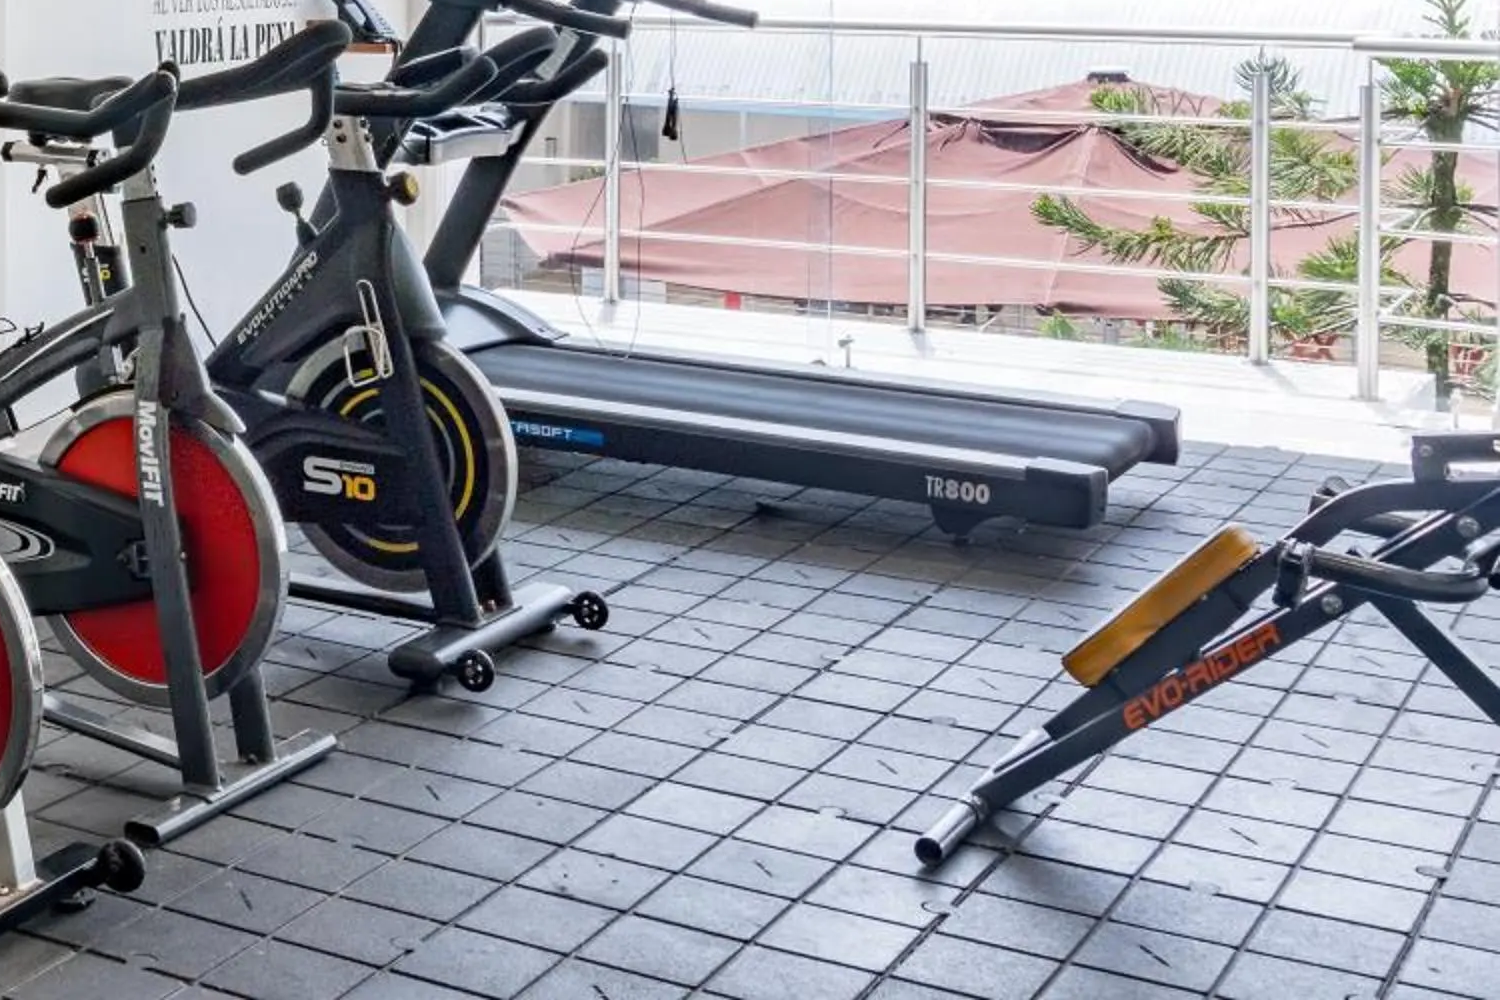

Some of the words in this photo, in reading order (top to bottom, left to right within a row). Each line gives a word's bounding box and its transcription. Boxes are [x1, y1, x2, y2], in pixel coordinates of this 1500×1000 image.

[155, 16, 225, 65] VALDRÁ
[230, 24, 250, 60] LA
[924, 475, 990, 505] TR800
